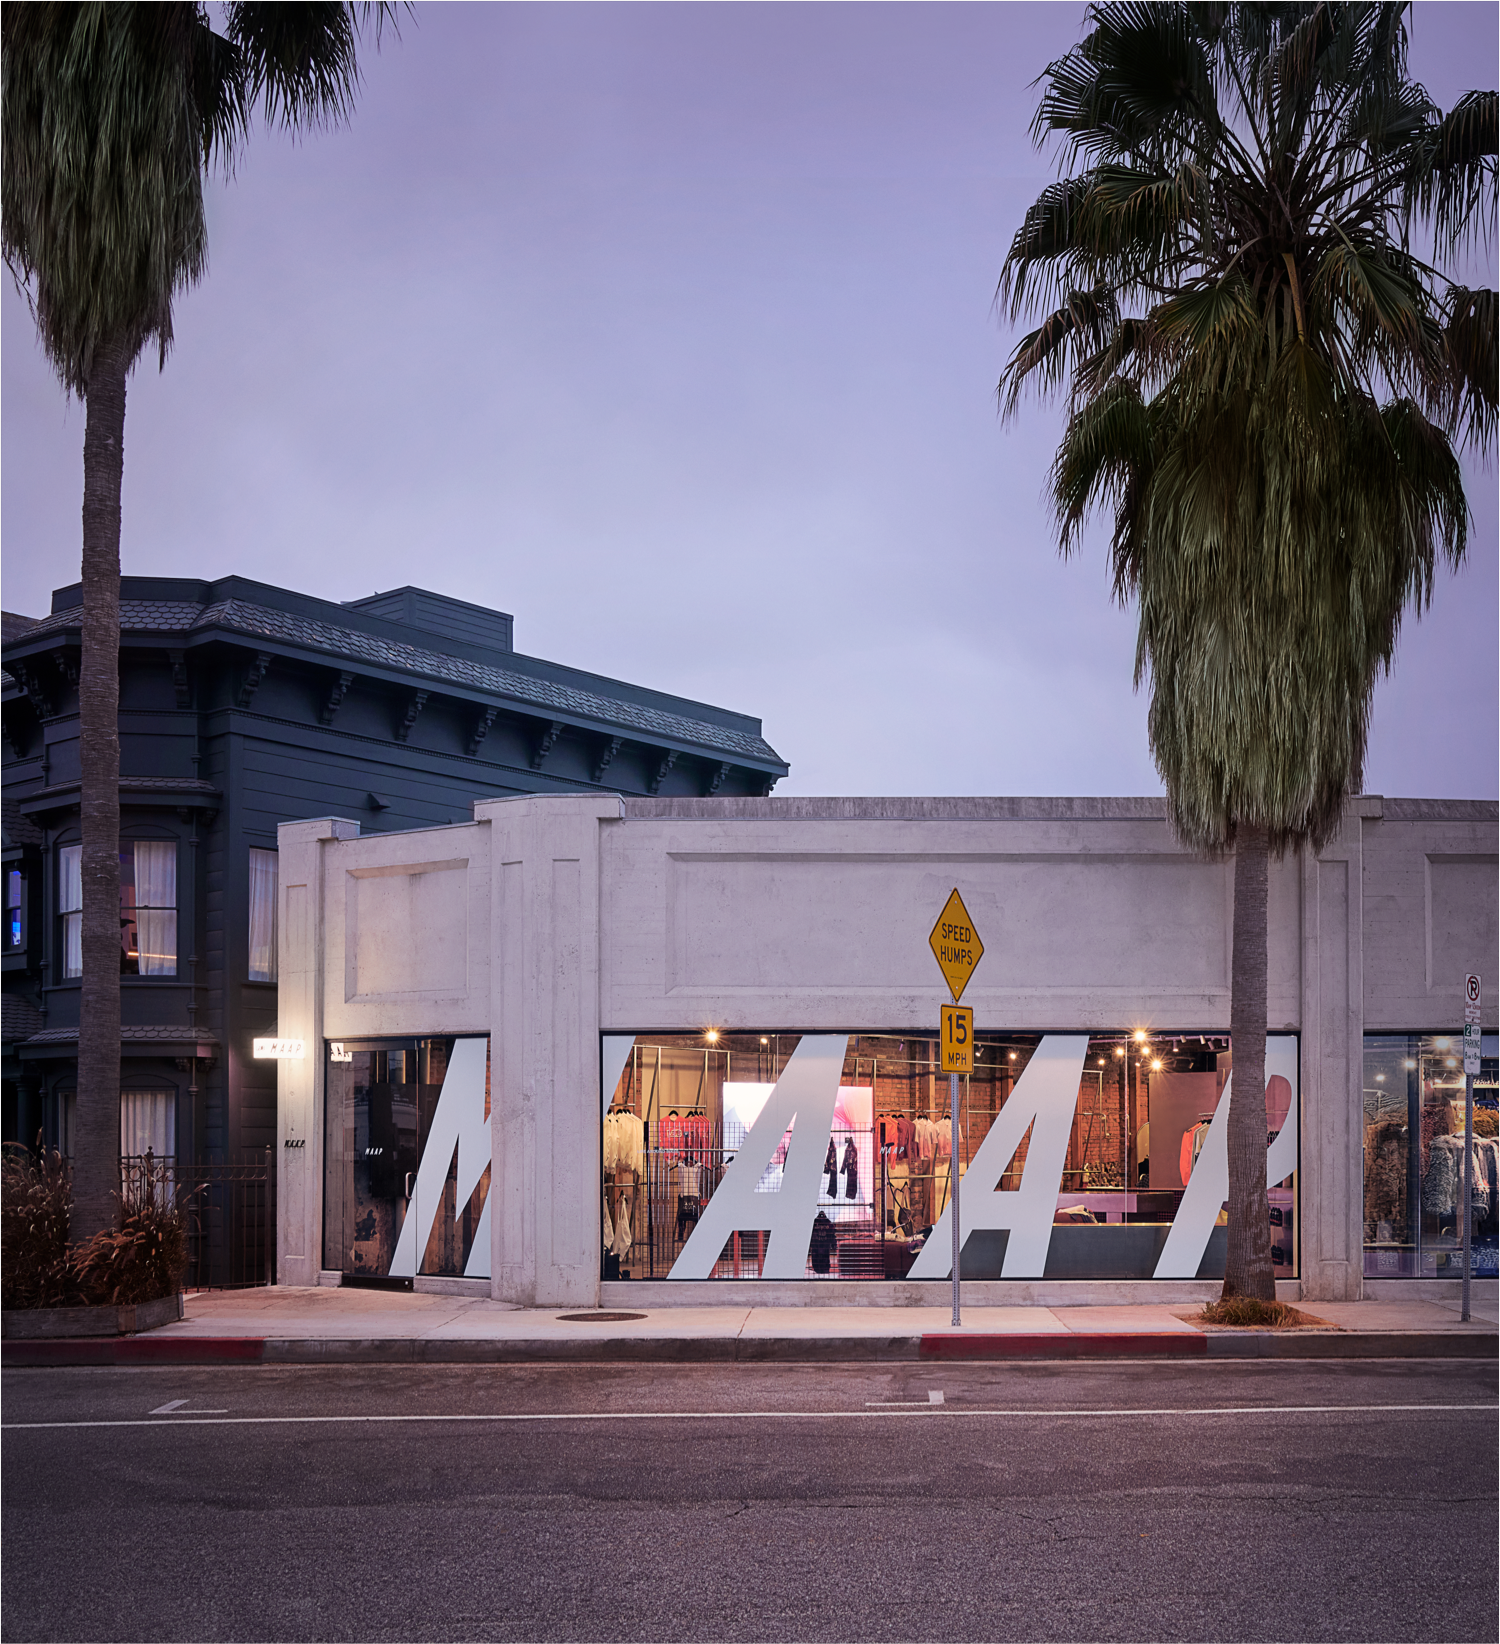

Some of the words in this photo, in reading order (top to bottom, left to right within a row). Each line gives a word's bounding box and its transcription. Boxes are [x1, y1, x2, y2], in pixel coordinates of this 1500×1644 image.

[941, 922, 971, 944] SPEED
[940, 945, 973, 966] HUMPS
[947, 1013, 968, 1045] 15
[1466, 1026, 1471, 1036] 2
[270, 1043, 302, 1054] MAAP
[1465, 1038, 1480, 1050] PARKING
[948, 1052, 967, 1066] MPH
[365, 1147, 383, 1156] MAAP
[879, 1146, 905, 1155] MAAP
